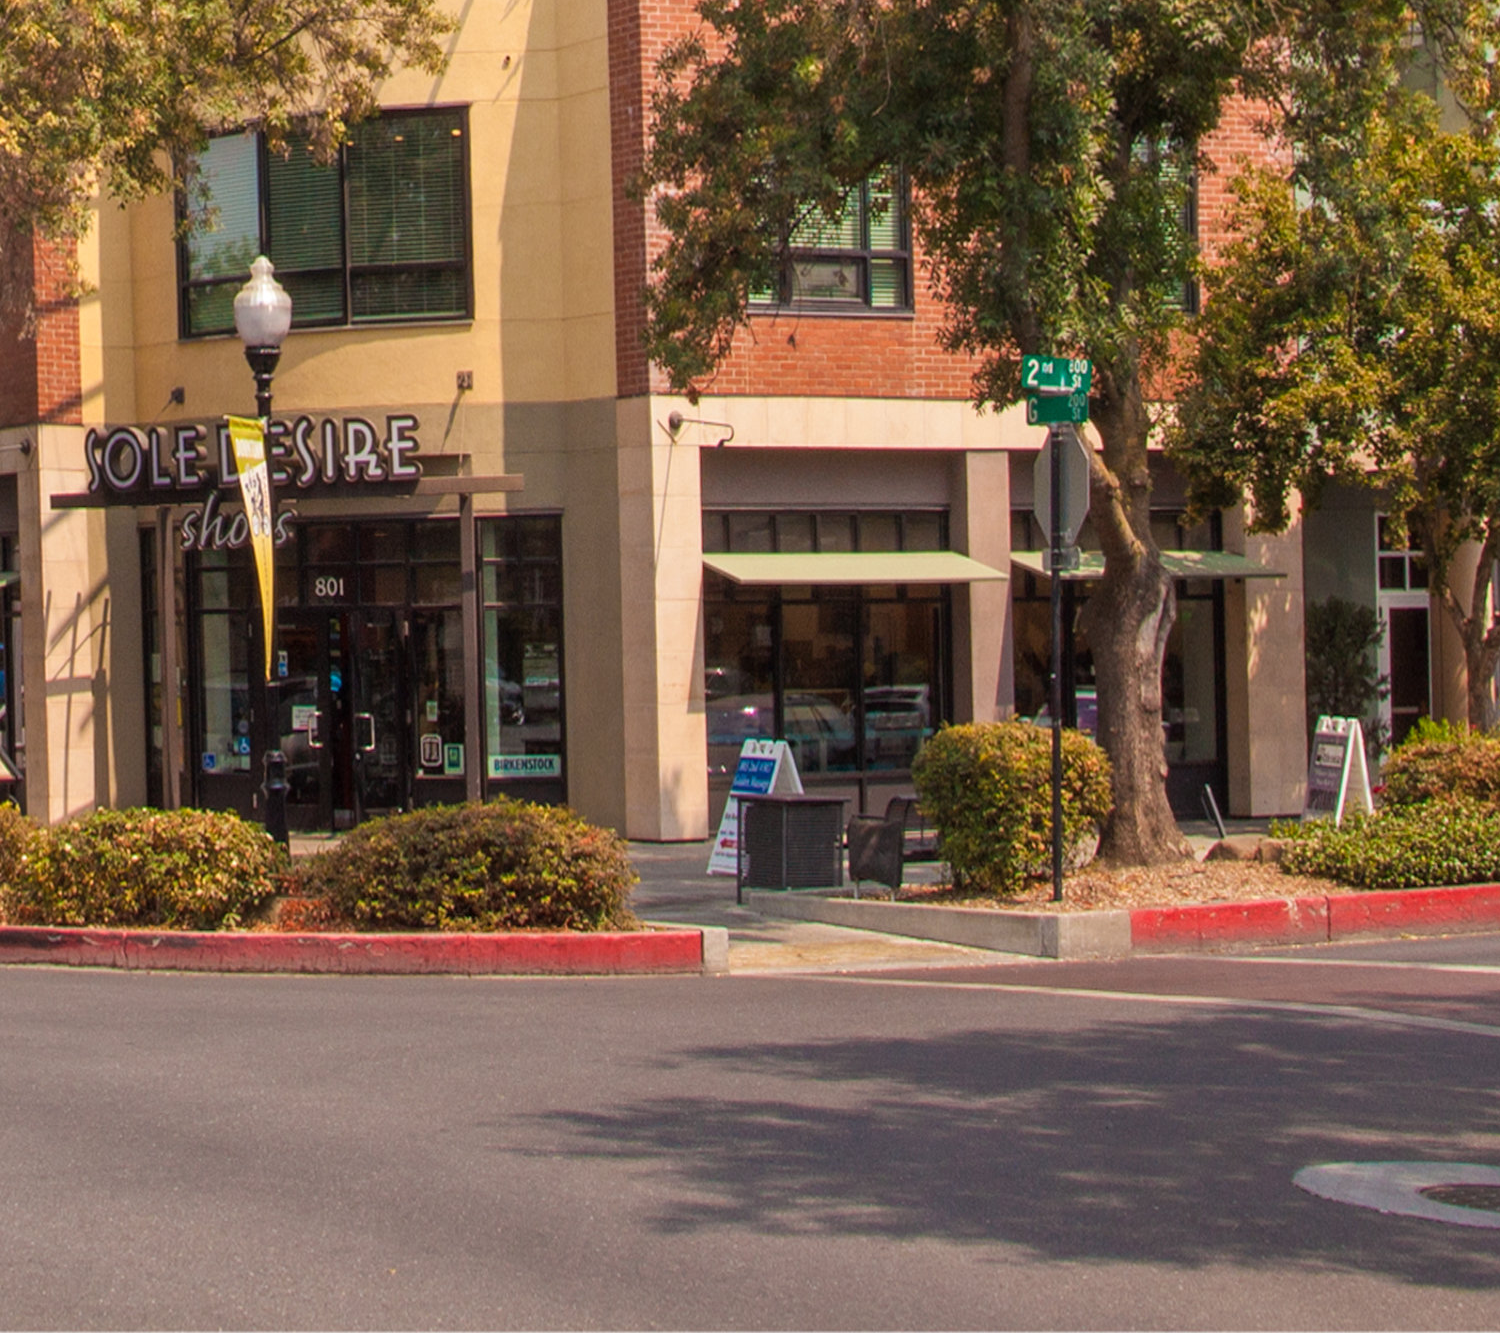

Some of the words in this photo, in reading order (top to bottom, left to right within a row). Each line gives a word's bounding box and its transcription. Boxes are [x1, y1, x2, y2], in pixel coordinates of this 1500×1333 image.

[1027, 359, 1053, 386] 2nd
[1072, 374, 1082, 388] St
[1028, 397, 1038, 423] G
[1072, 407, 1081, 421] St
[85, 425, 202, 491] SOLE
[180, 489, 297, 549] shos
[315, 577, 345, 598] 801
[494, 758, 555, 771] BIRKENSTOCK
